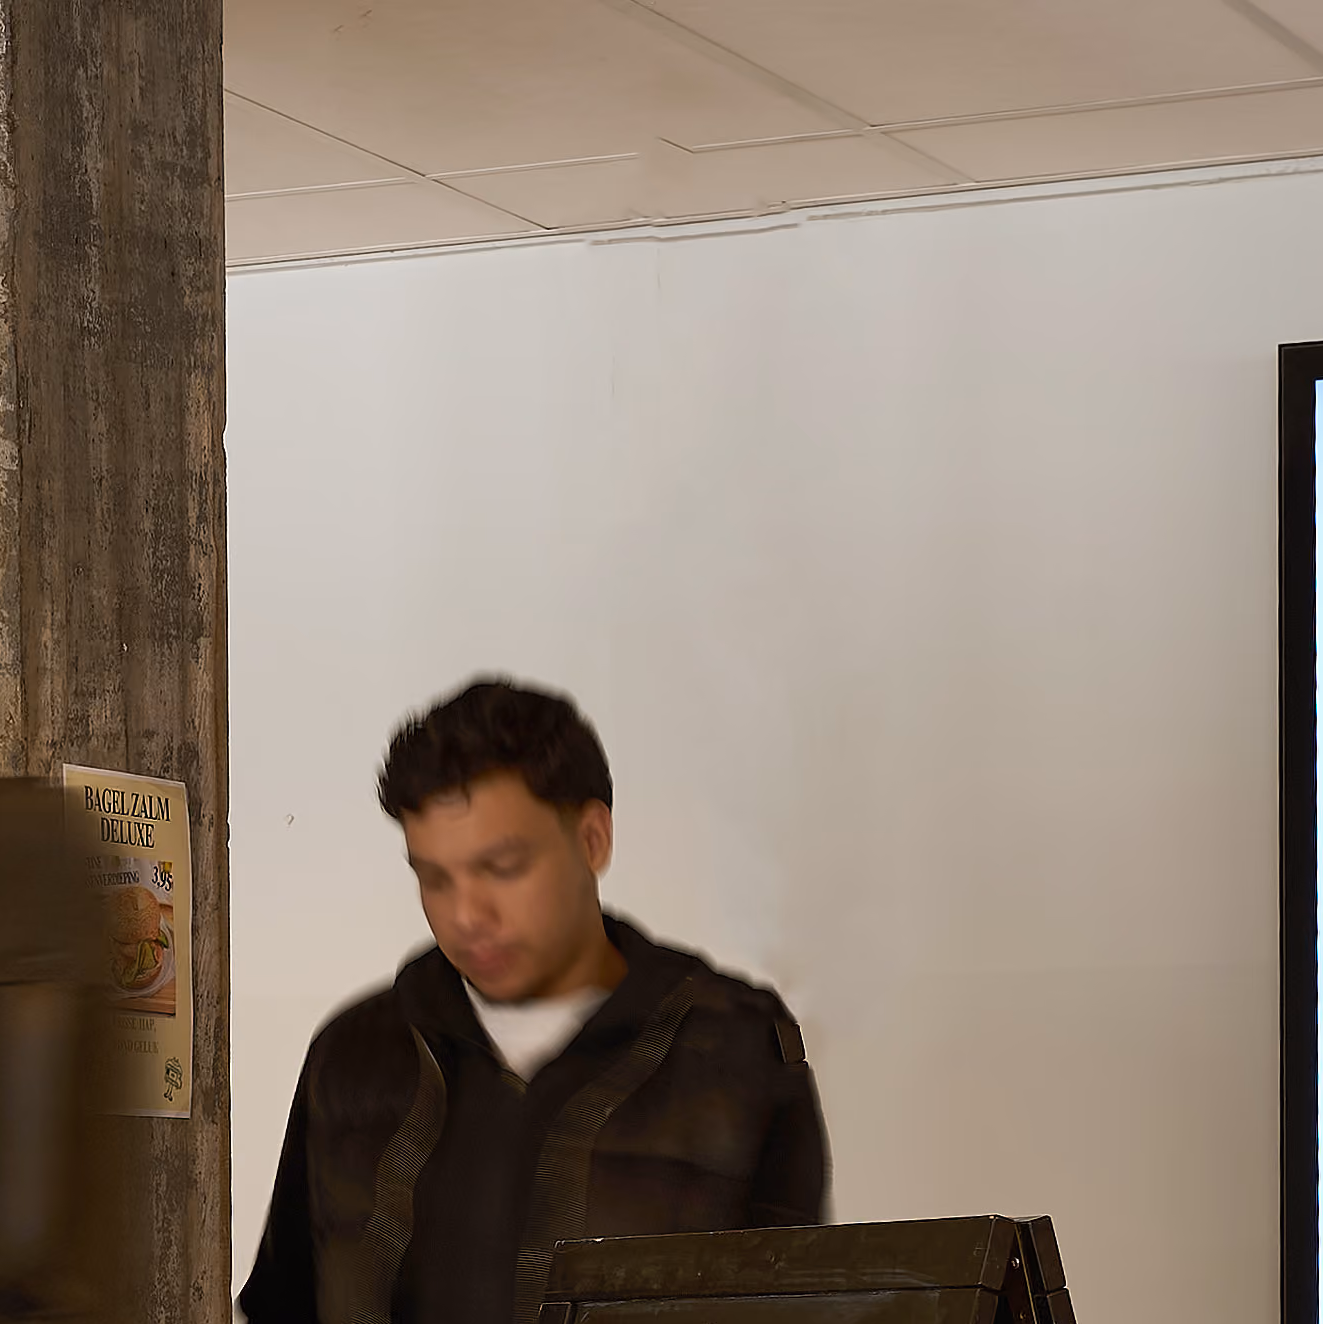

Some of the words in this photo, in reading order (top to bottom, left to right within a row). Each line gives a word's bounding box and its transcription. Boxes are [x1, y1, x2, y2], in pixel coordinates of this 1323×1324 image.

[84, 785, 130, 815] BAGEL
[130, 792, 172, 822] ZALM
[100, 816, 156, 849] DELUXE
